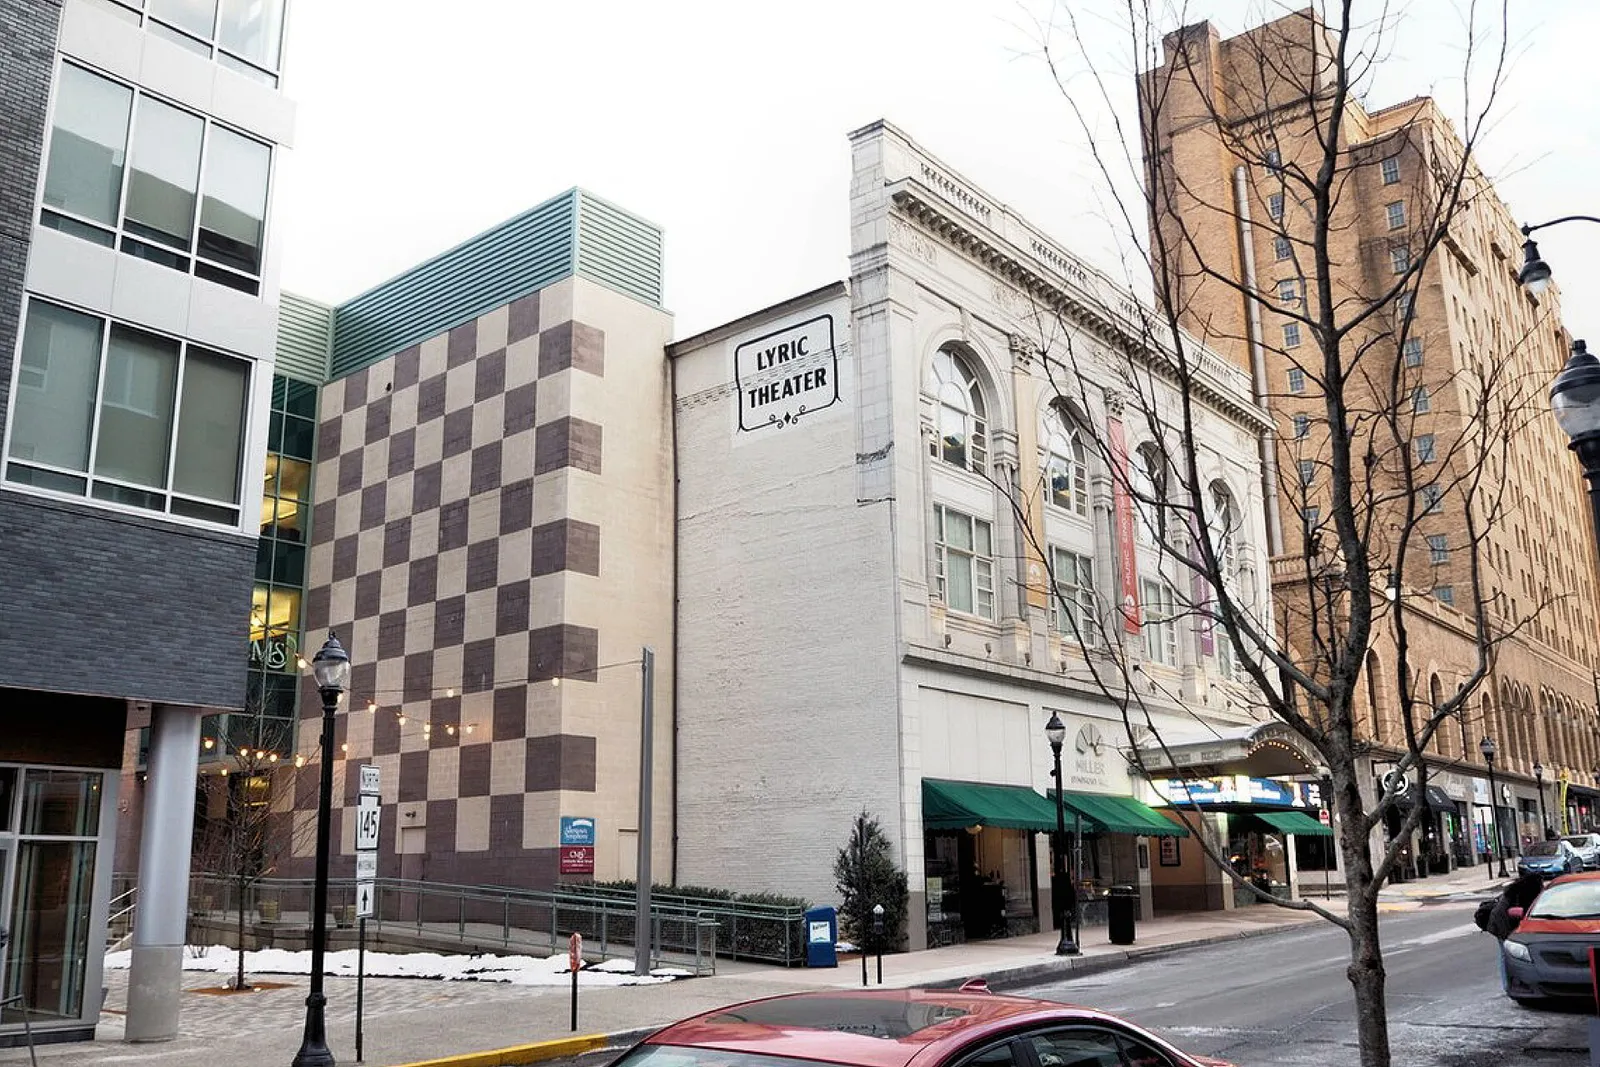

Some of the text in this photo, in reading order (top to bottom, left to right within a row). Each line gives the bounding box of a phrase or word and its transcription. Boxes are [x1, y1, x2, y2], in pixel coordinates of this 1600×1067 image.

[757, 335, 809, 371] LYRIC
[748, 367, 827, 408] THEATER
[359, 811, 377, 839] 145
